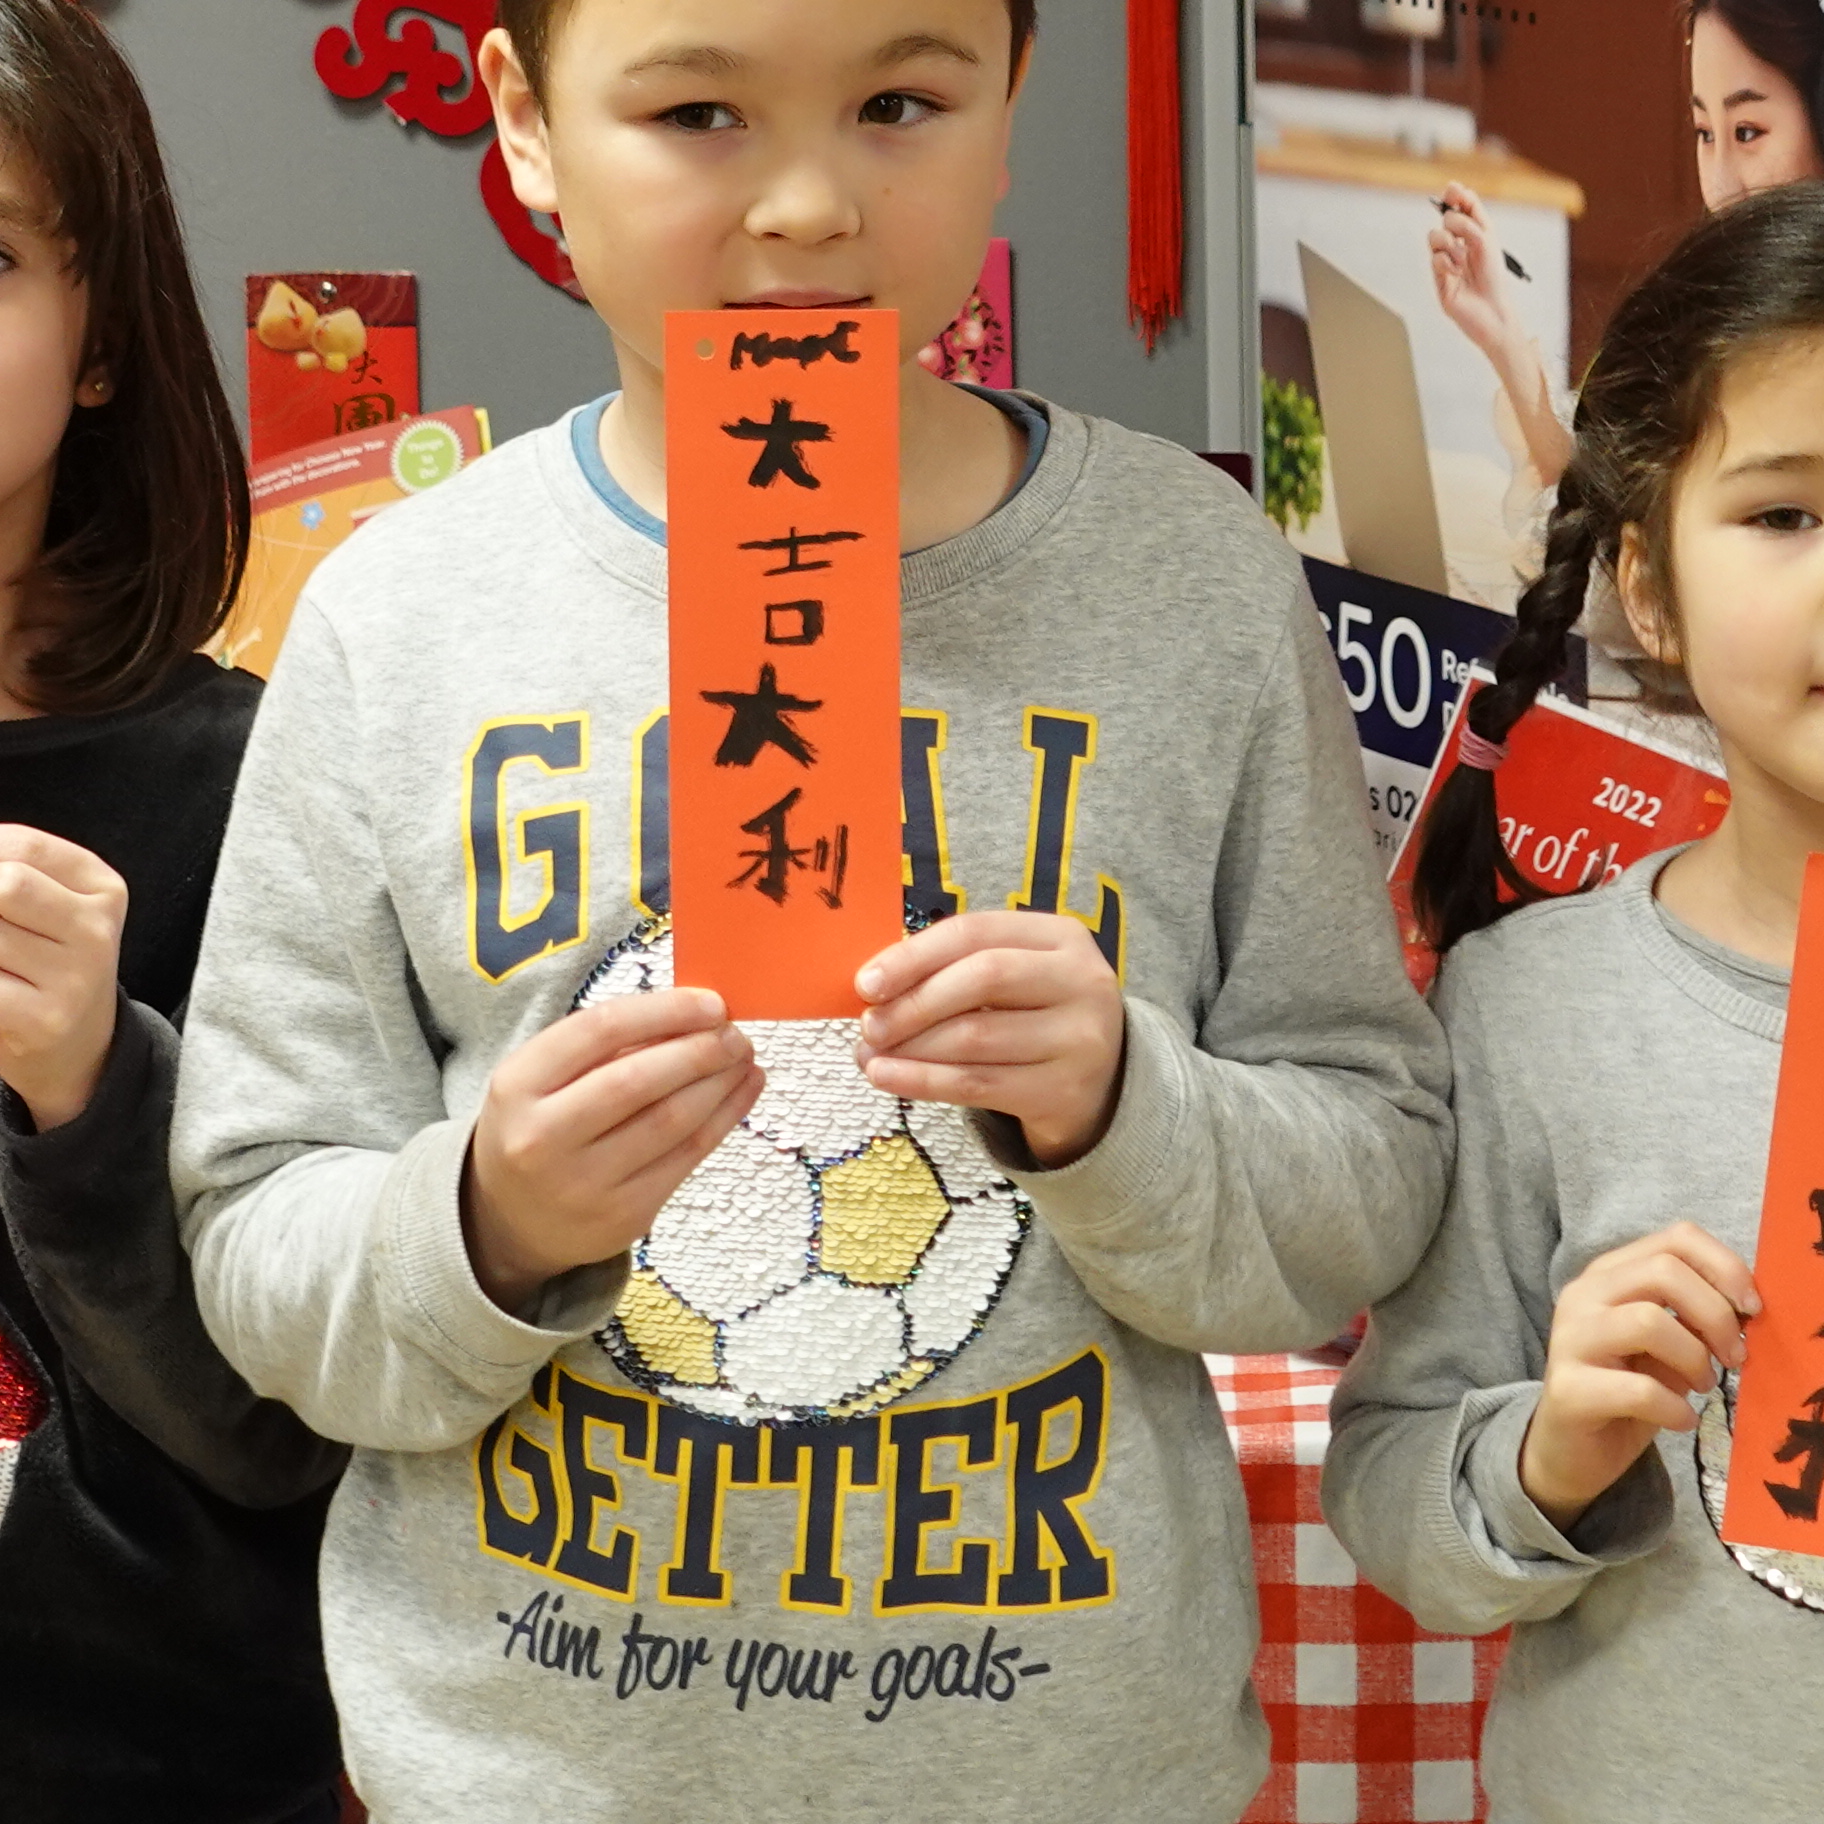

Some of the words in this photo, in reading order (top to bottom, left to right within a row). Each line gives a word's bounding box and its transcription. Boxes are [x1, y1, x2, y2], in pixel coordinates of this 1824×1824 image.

[699, 397, 865, 909] 大吉大利
[1593, 777, 1662, 827] 2022
[1533, 828, 1589, 880] of
[473, 1343, 1116, 1618] GETTER
[617, 1612, 710, 1698] for
[727, 1625, 856, 1708] your
